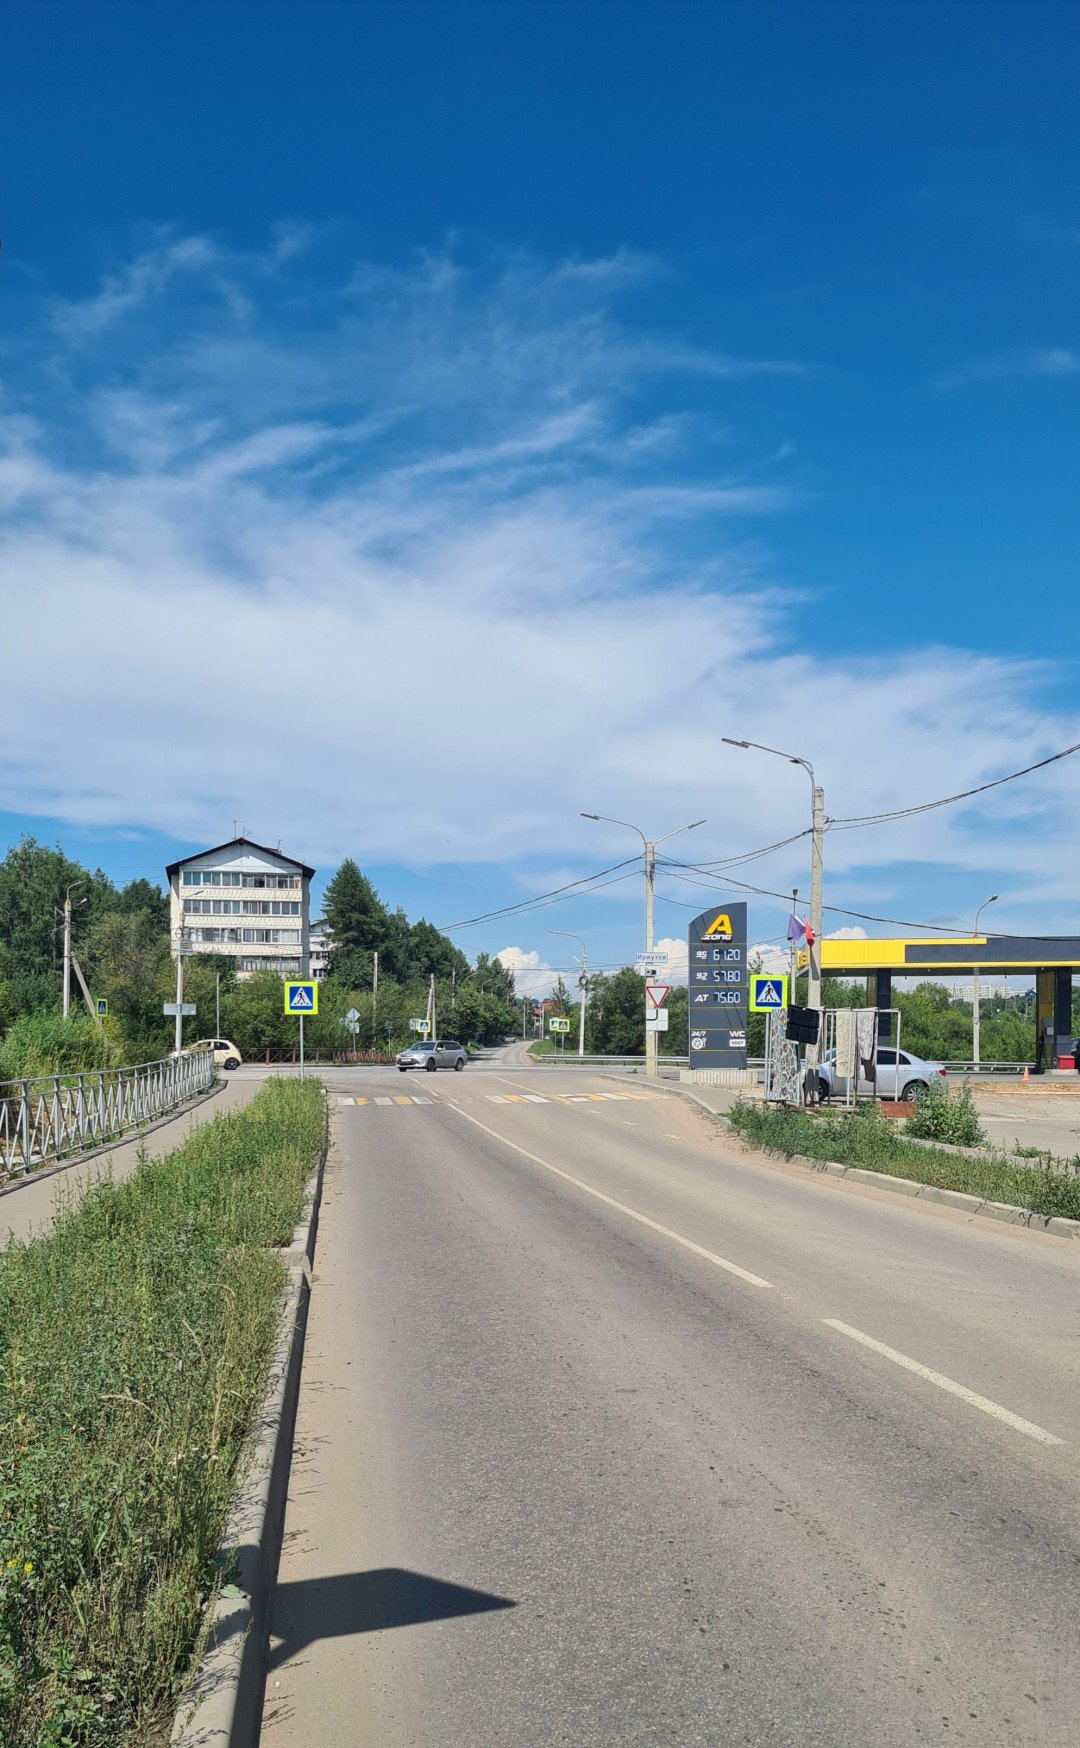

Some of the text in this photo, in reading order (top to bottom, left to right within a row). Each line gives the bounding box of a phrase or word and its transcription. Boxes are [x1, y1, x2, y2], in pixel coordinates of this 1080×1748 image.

[706, 914, 732, 934] A
[696, 950, 708, 959] 95
[696, 972, 708, 981] 92
